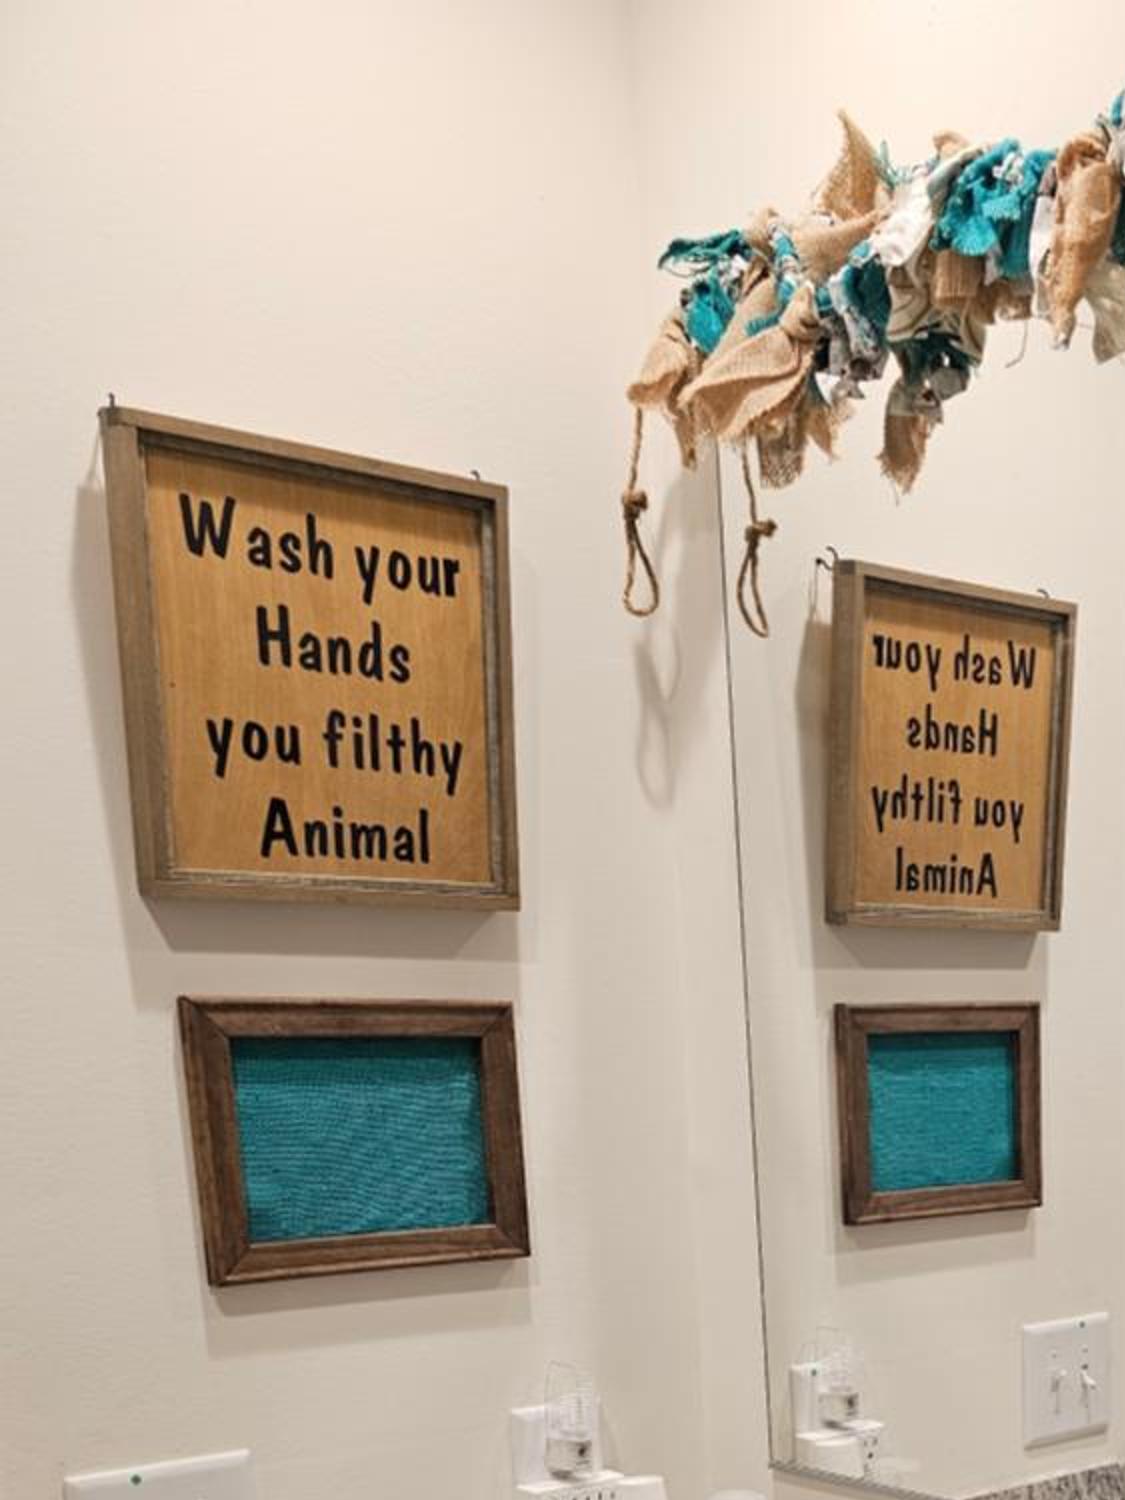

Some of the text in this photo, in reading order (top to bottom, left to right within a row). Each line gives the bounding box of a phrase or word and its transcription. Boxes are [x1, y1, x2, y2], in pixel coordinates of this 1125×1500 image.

[178, 492, 461, 605] Wash your
[256, 603, 412, 684] Hands
[206, 709, 464, 797] you filthy
[259, 796, 431, 864] Animal
